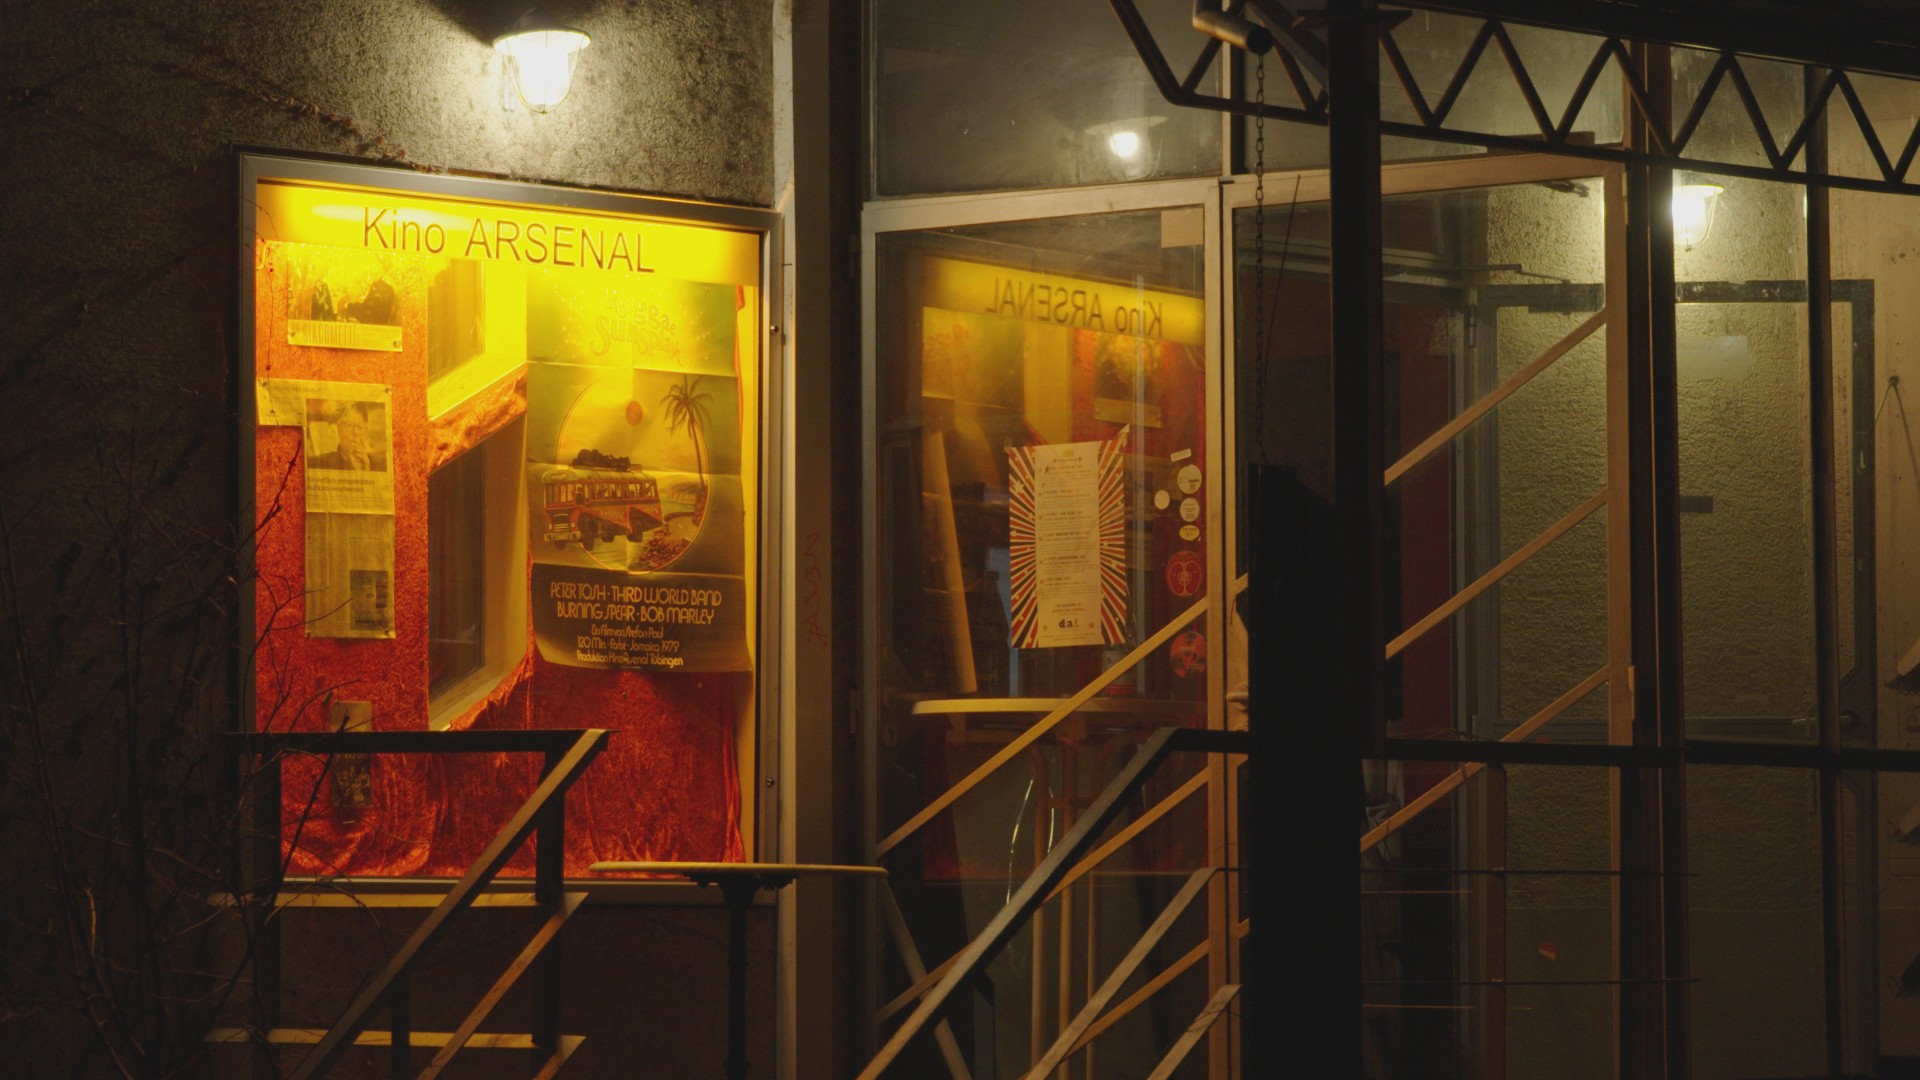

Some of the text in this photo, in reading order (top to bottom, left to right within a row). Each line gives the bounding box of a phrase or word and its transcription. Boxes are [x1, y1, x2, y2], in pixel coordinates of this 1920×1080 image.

[364, 206, 655, 274] Kino ARSENAL
[550, 581, 722, 607] PETER TOSH THIRD WORLD BAND
[557, 601, 715, 625] BURNING SPEAR BOB MARLEY
[624, 625, 648, 638] Stefan
[648, 626, 664, 639] Paul
[577, 636, 591, 649] 120
[629, 640, 660, 652] Jamaica
[661, 640, 680, 653] 1979
